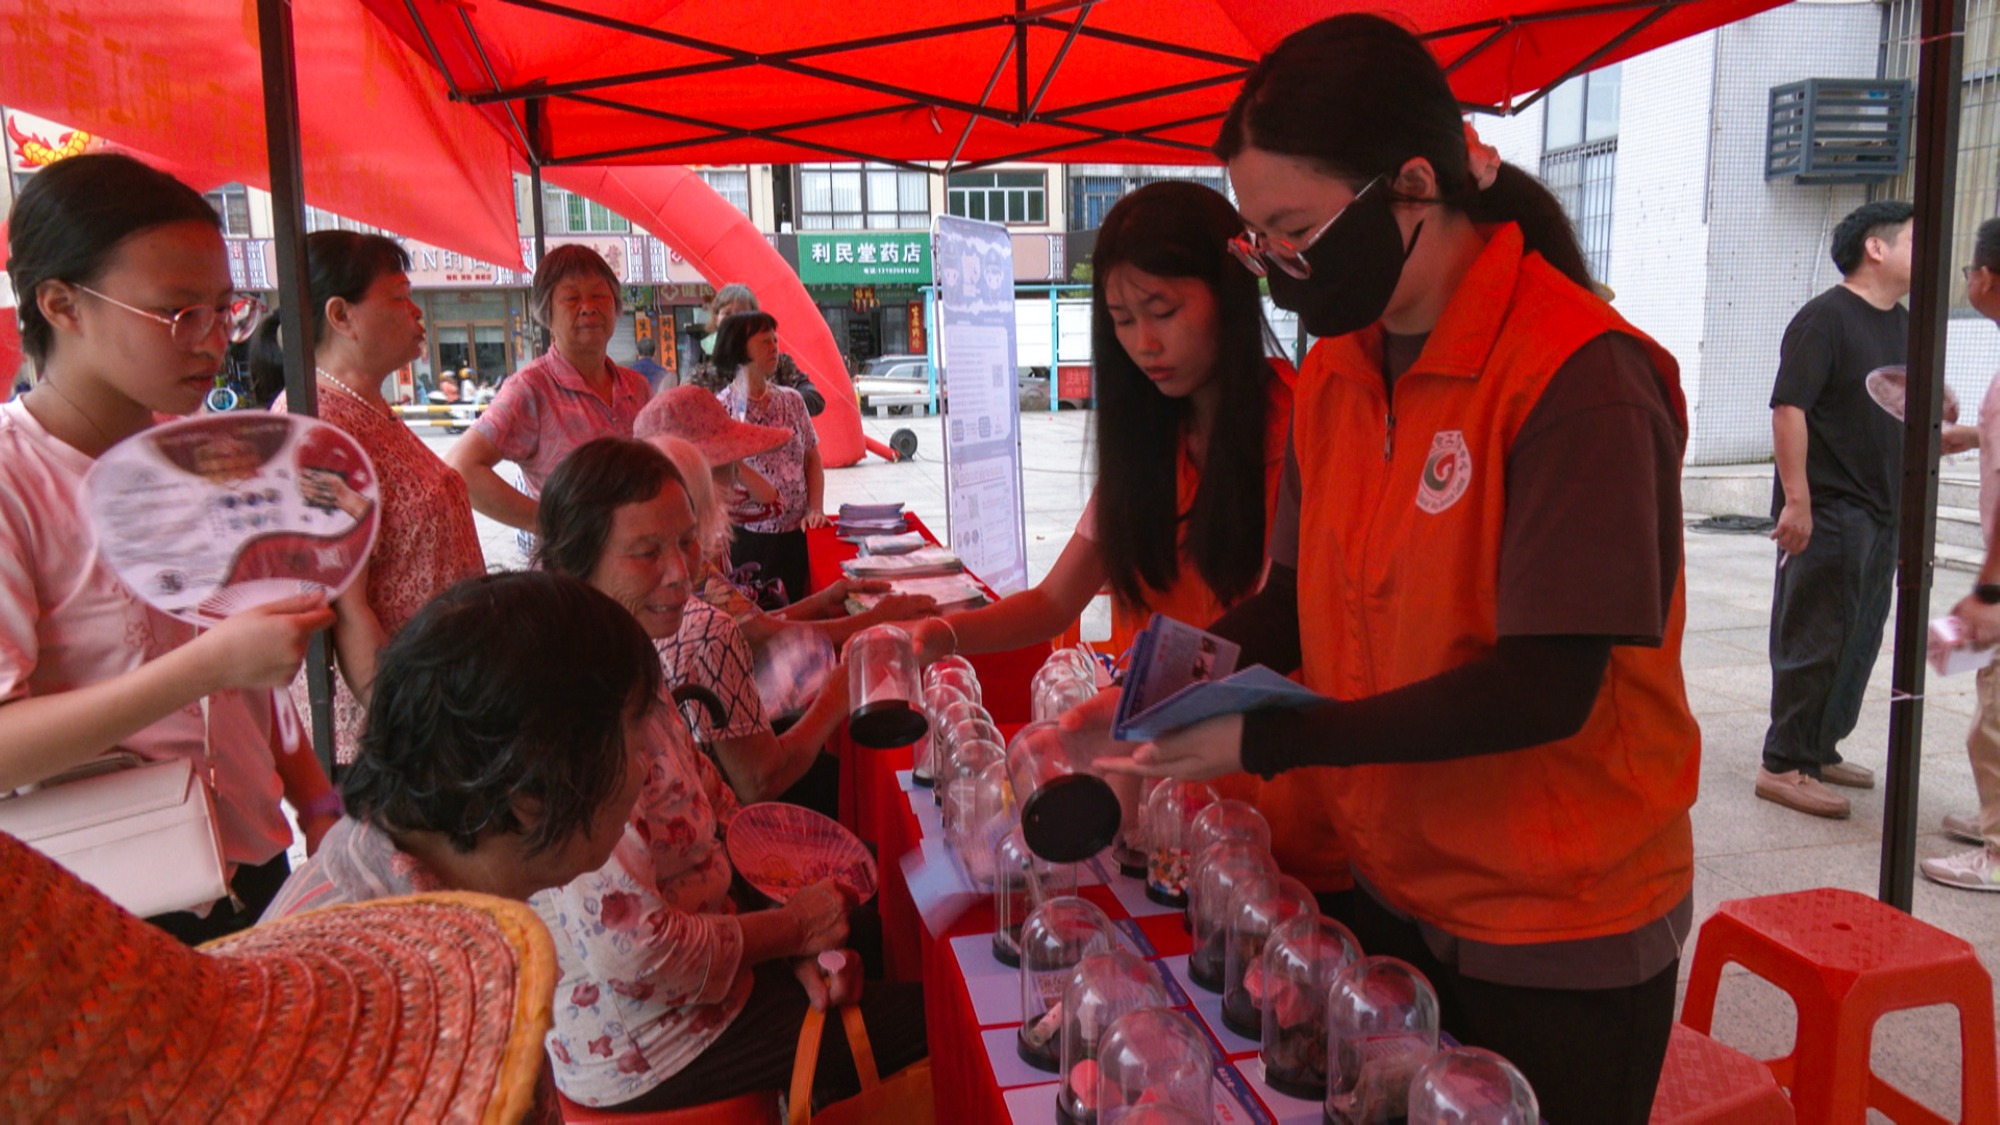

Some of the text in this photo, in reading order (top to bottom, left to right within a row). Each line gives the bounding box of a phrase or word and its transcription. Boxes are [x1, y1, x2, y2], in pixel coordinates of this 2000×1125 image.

[811, 242, 922, 264] 利民堂药店
